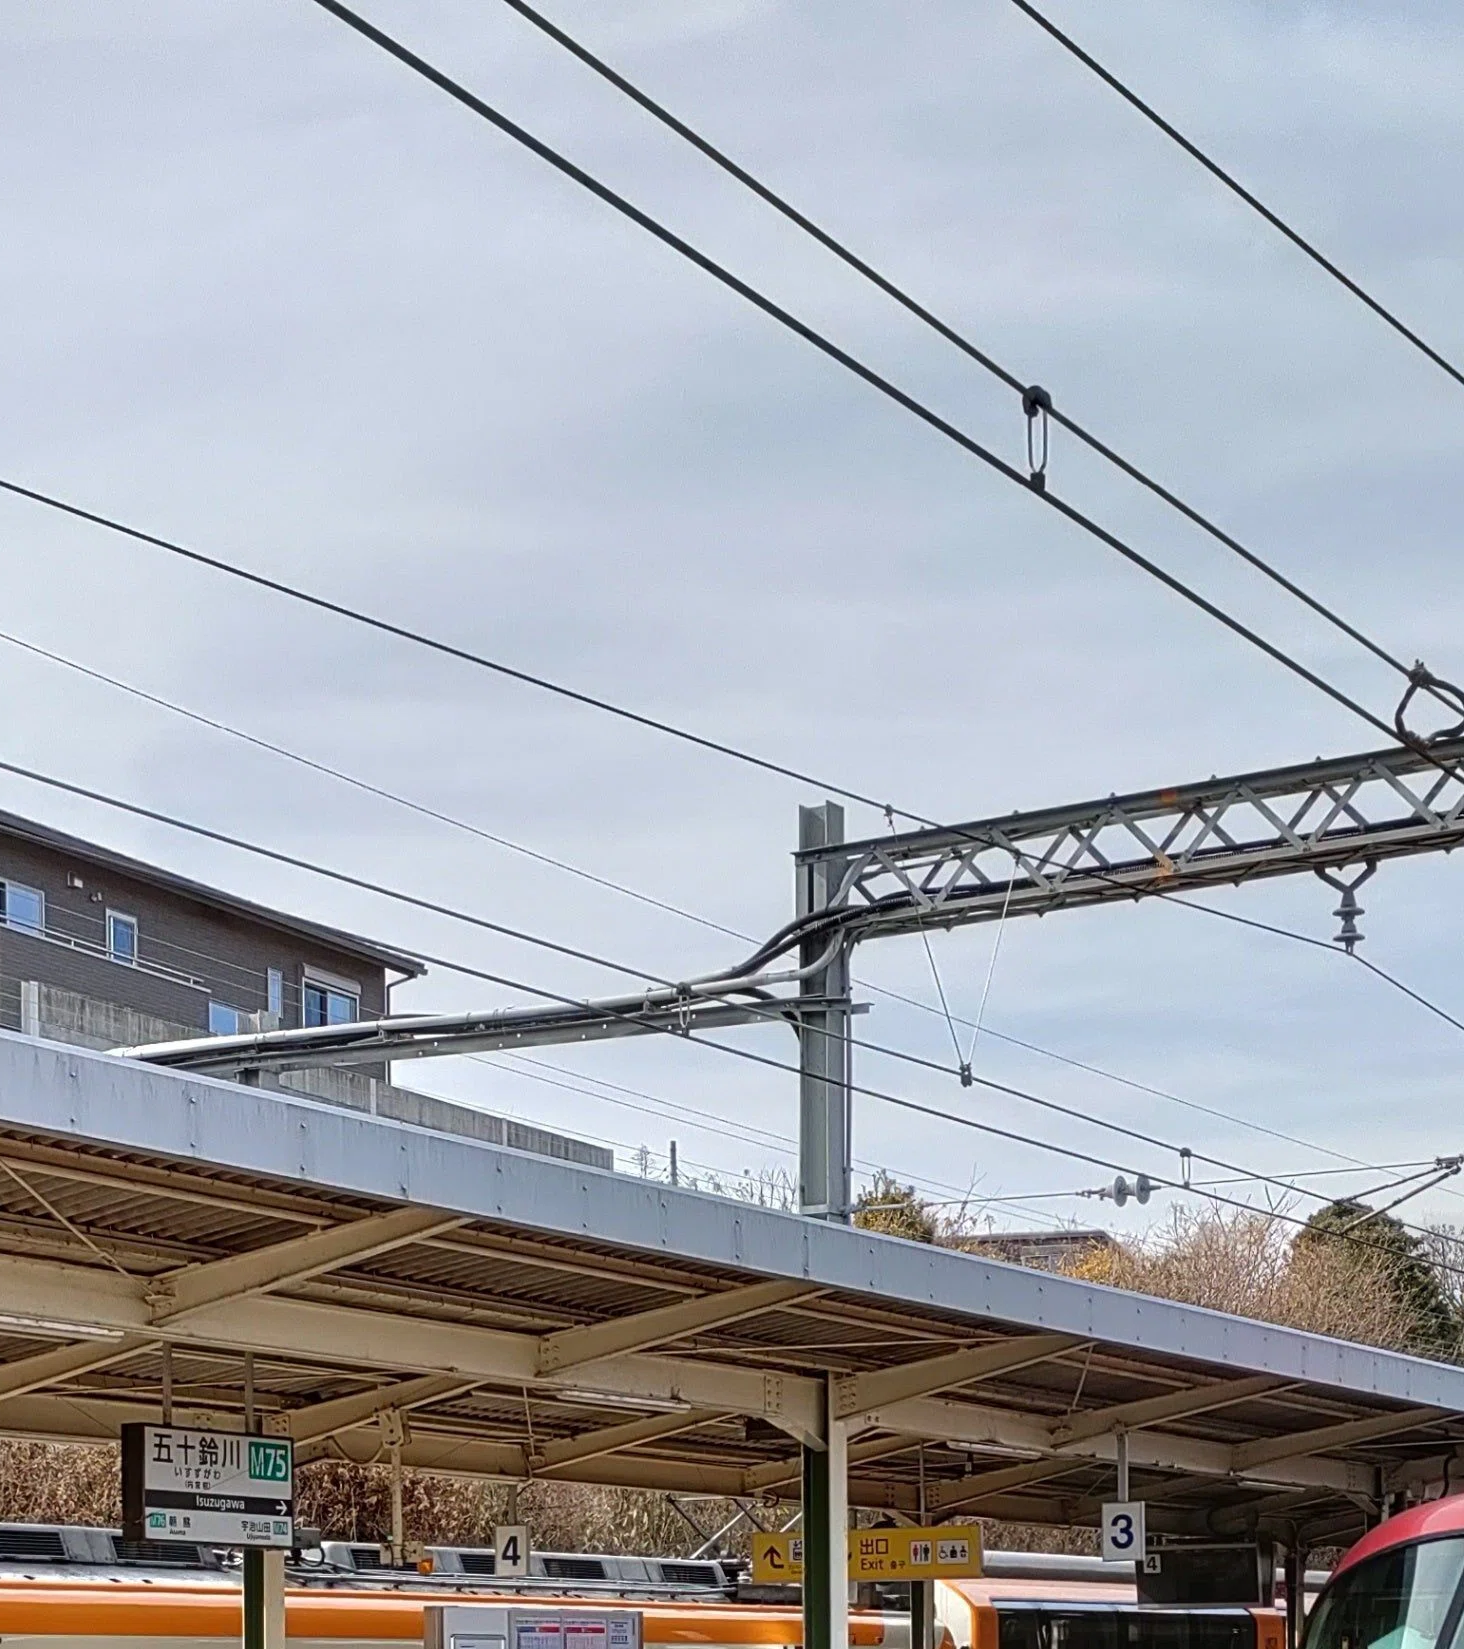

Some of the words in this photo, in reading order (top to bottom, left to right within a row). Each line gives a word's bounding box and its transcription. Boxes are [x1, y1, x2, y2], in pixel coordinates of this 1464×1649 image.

[152, 1432, 241, 1470] 五十鈴川
[250, 1445, 286, 1478] M75
[174, 1467, 222, 1480] いすずがわ
[195, 1494, 245, 1512] Isuzugawa
[1110, 1514, 1134, 1549] 3
[502, 1535, 521, 1566] 4
[860, 1538, 889, 1555] 出口
[860, 1558, 884, 1571] Exit
[1146, 1556, 1158, 1571] 4
